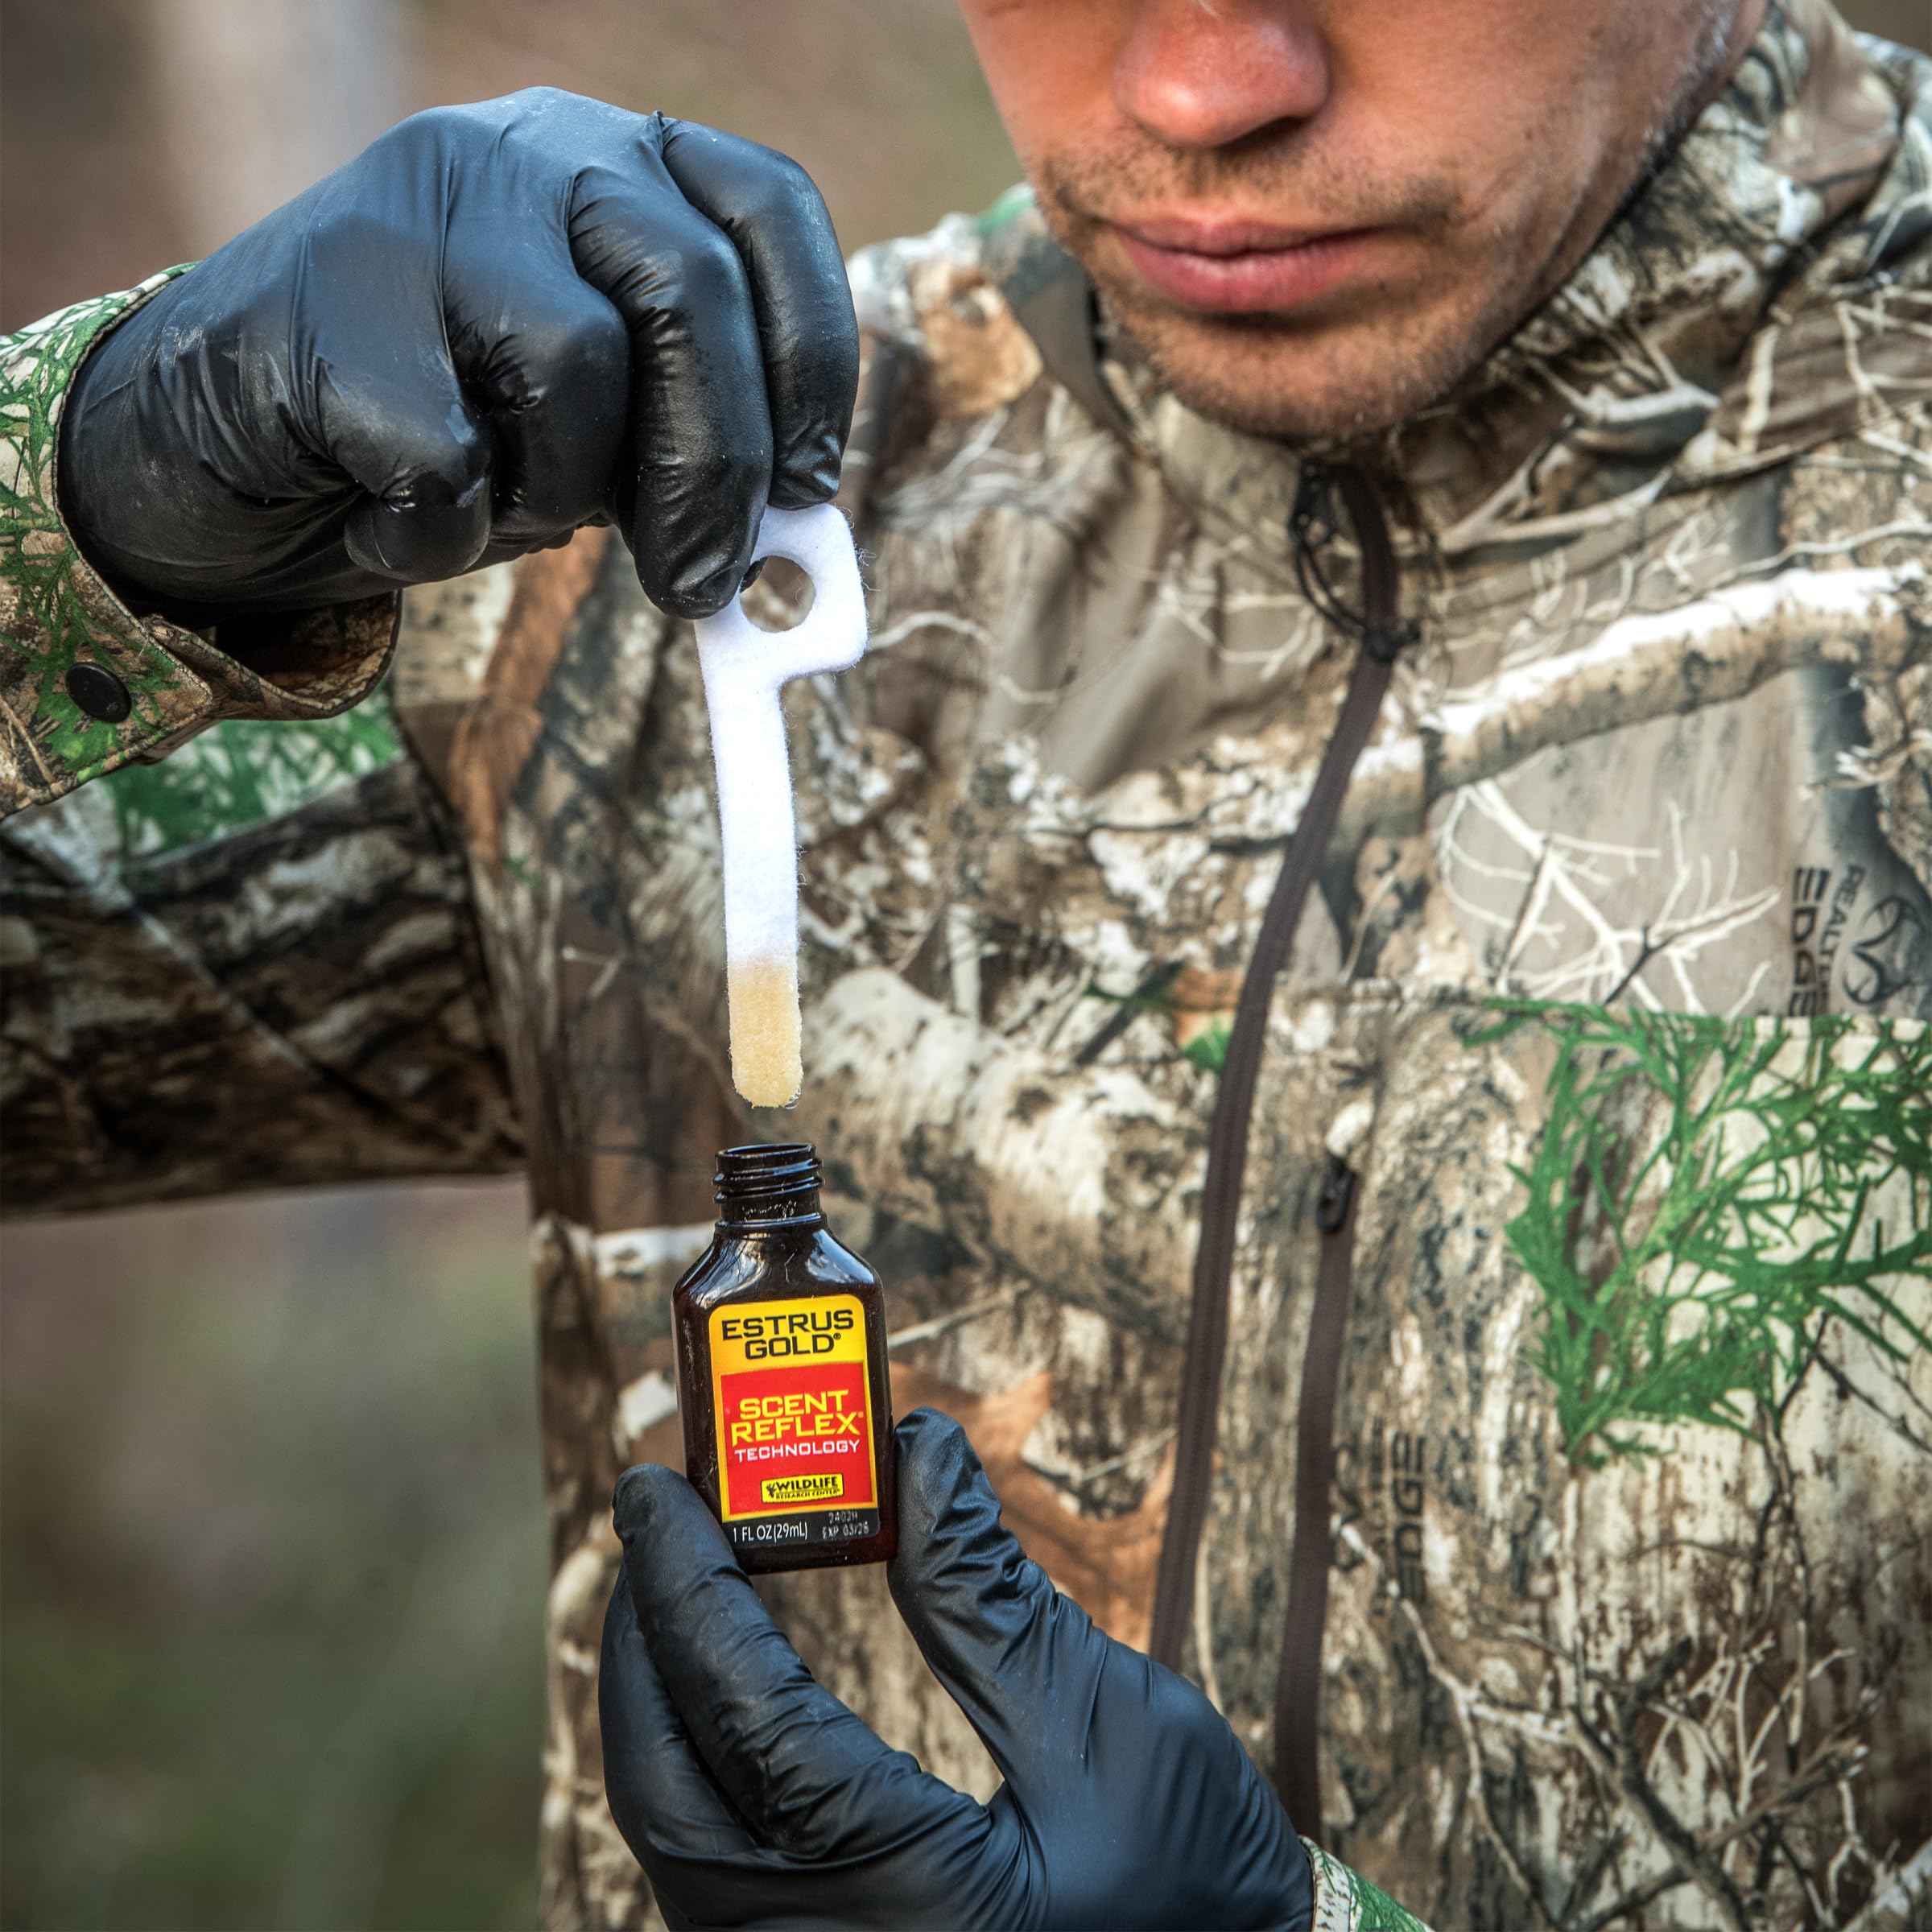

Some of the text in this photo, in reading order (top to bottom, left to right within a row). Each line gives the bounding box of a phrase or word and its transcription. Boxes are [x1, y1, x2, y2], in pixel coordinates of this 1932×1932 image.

[1789, 866, 1831, 1016] EDGE
[721, 1309, 854, 1341] ESTRUS
[740, 1389, 849, 1420] SCENT
[734, 1439, 861, 1463] TECHNOLOGY
[775, 1476, 838, 1491] WILDLIFE
[776, 1491, 811, 1500] RESEARCH
[733, 1527, 737, 1543] 1
[741, 1525, 754, 1542] FL
